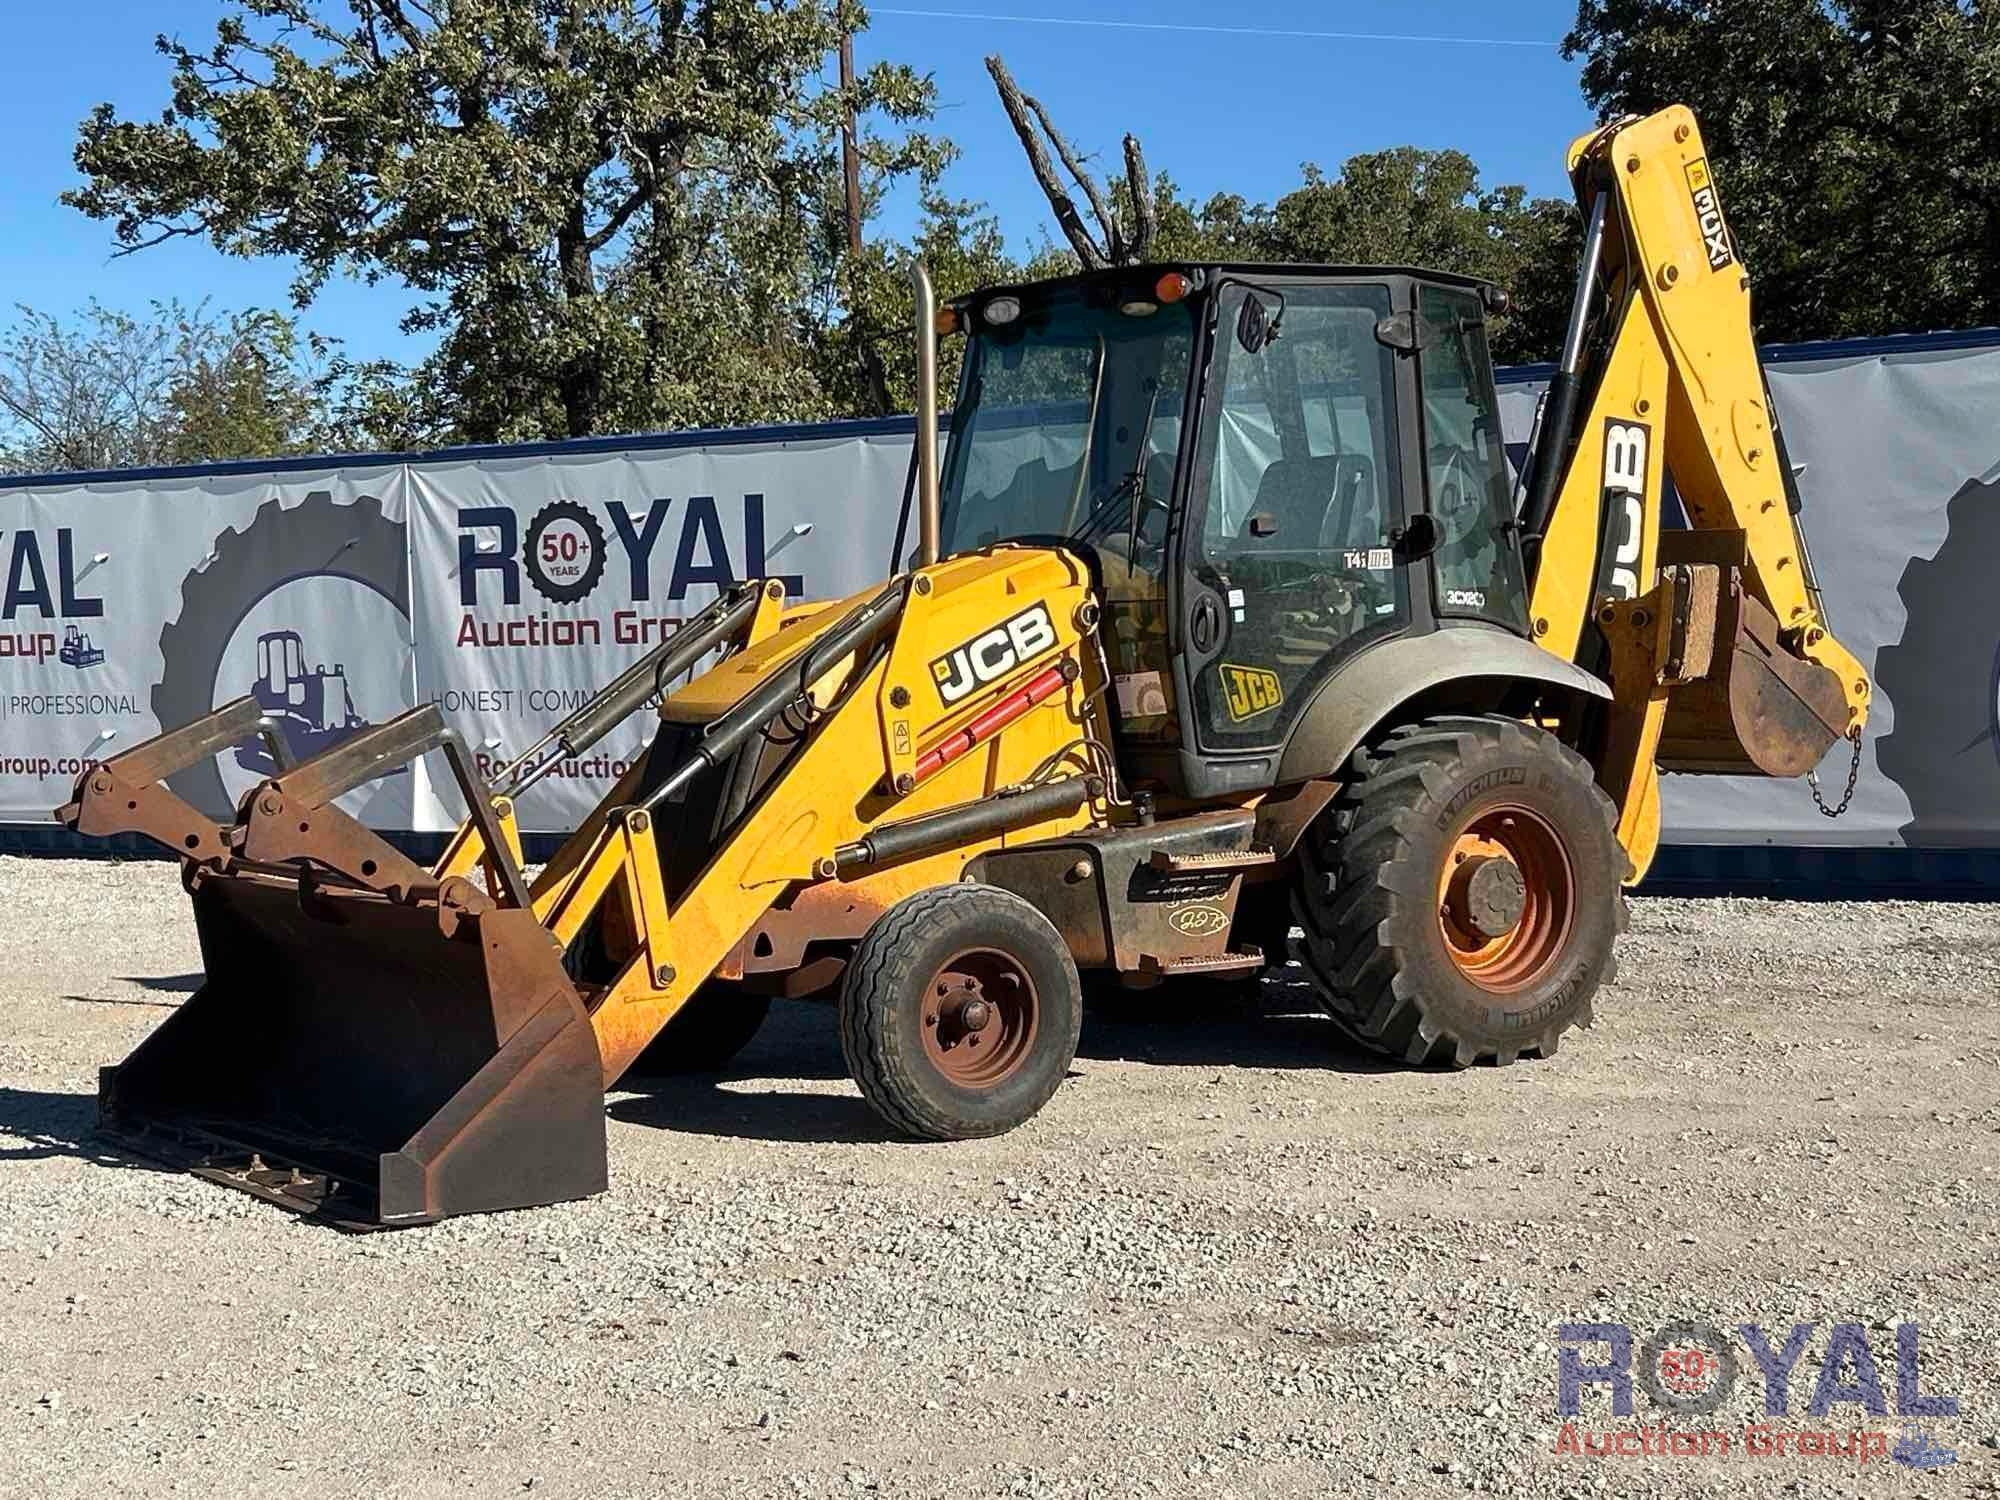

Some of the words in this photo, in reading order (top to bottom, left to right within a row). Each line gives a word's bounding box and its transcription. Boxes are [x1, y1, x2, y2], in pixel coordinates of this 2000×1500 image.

[543, 532, 589, 562] 50+
[550, 567, 580, 576] YEARS
[457, 613, 600, 646] Auction
[941, 607, 1055, 701] JCB
[11, 695, 142, 714] PROFESSIONAL
[431, 690, 513, 712] HONEST
[1231, 669, 1279, 716] JCB
